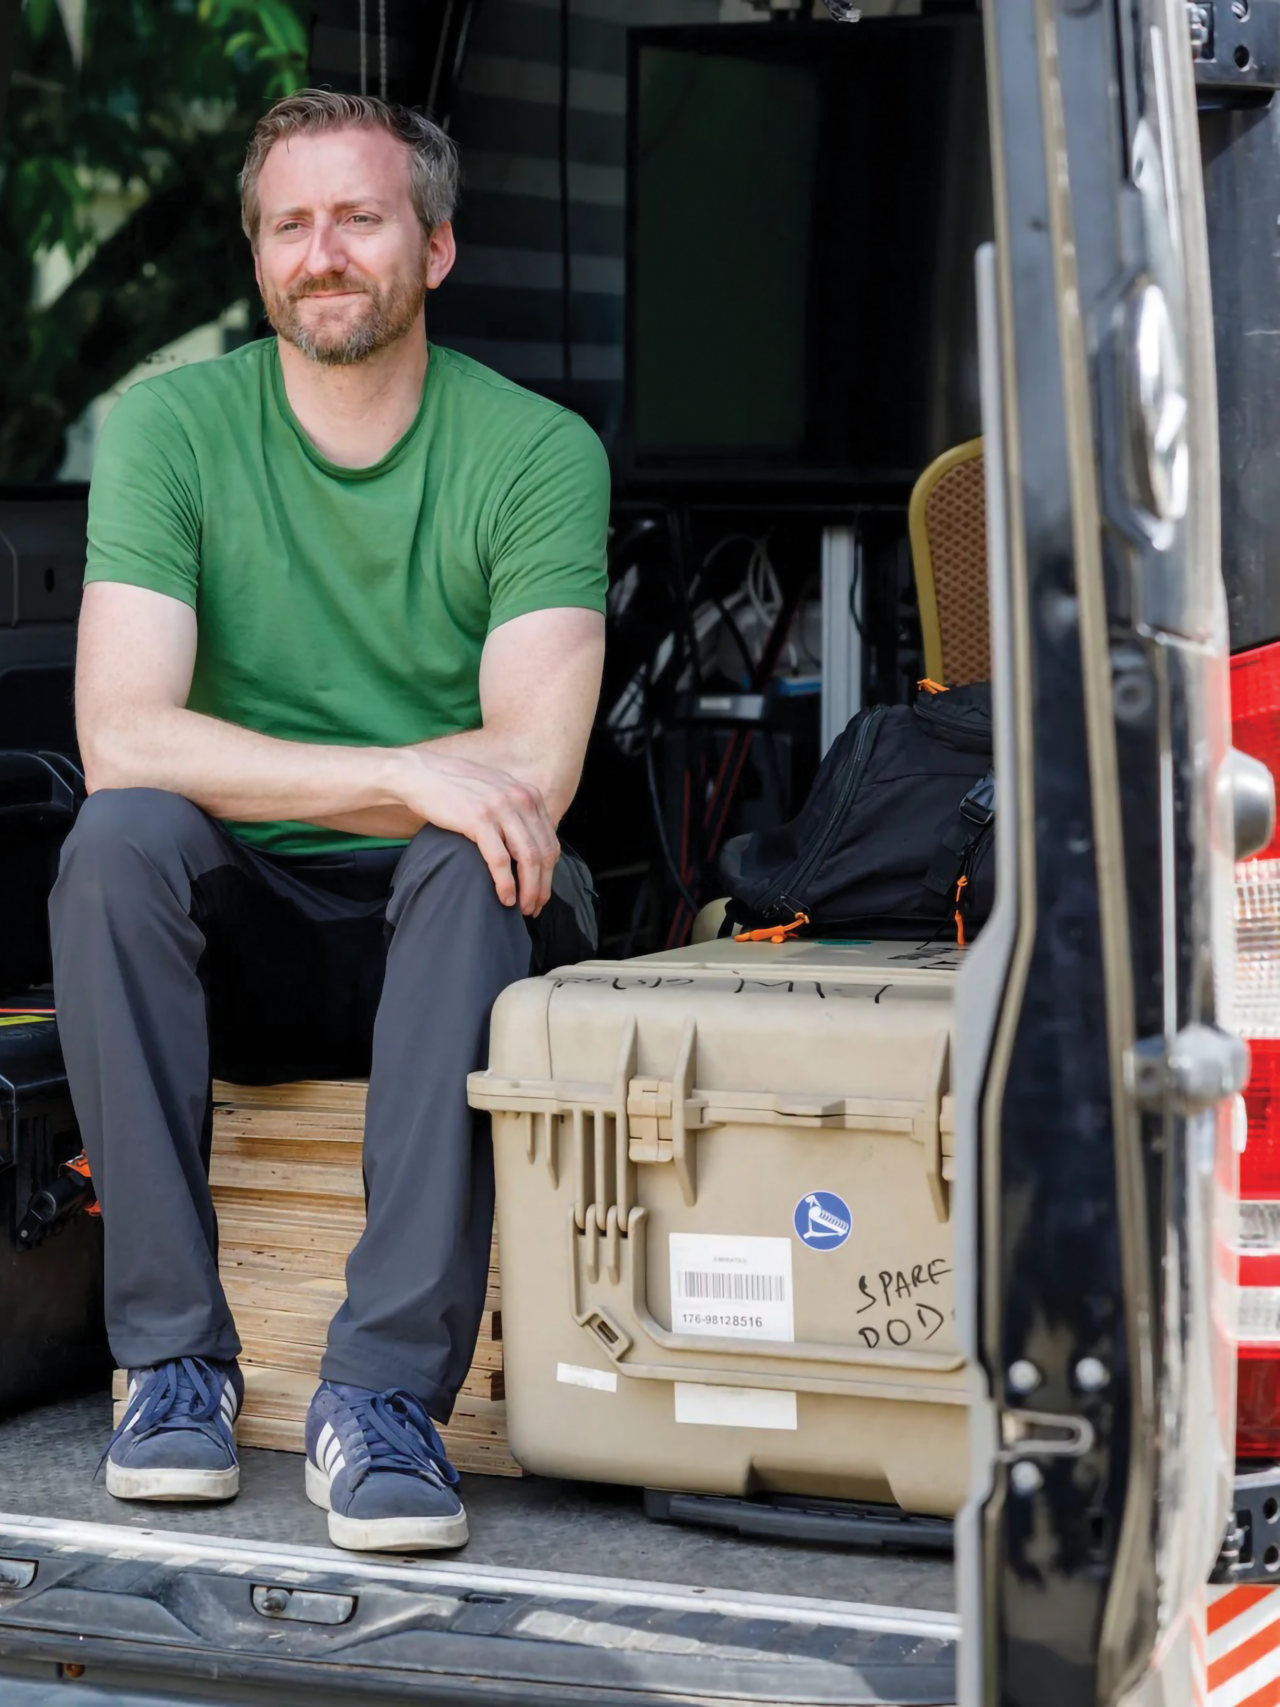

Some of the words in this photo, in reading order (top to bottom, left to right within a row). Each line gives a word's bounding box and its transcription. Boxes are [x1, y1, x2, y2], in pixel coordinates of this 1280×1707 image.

[856, 1258, 954, 1314] SPARE
[682, 1313, 763, 1328] 176-98128516
[858, 1302, 955, 1348] DOD
